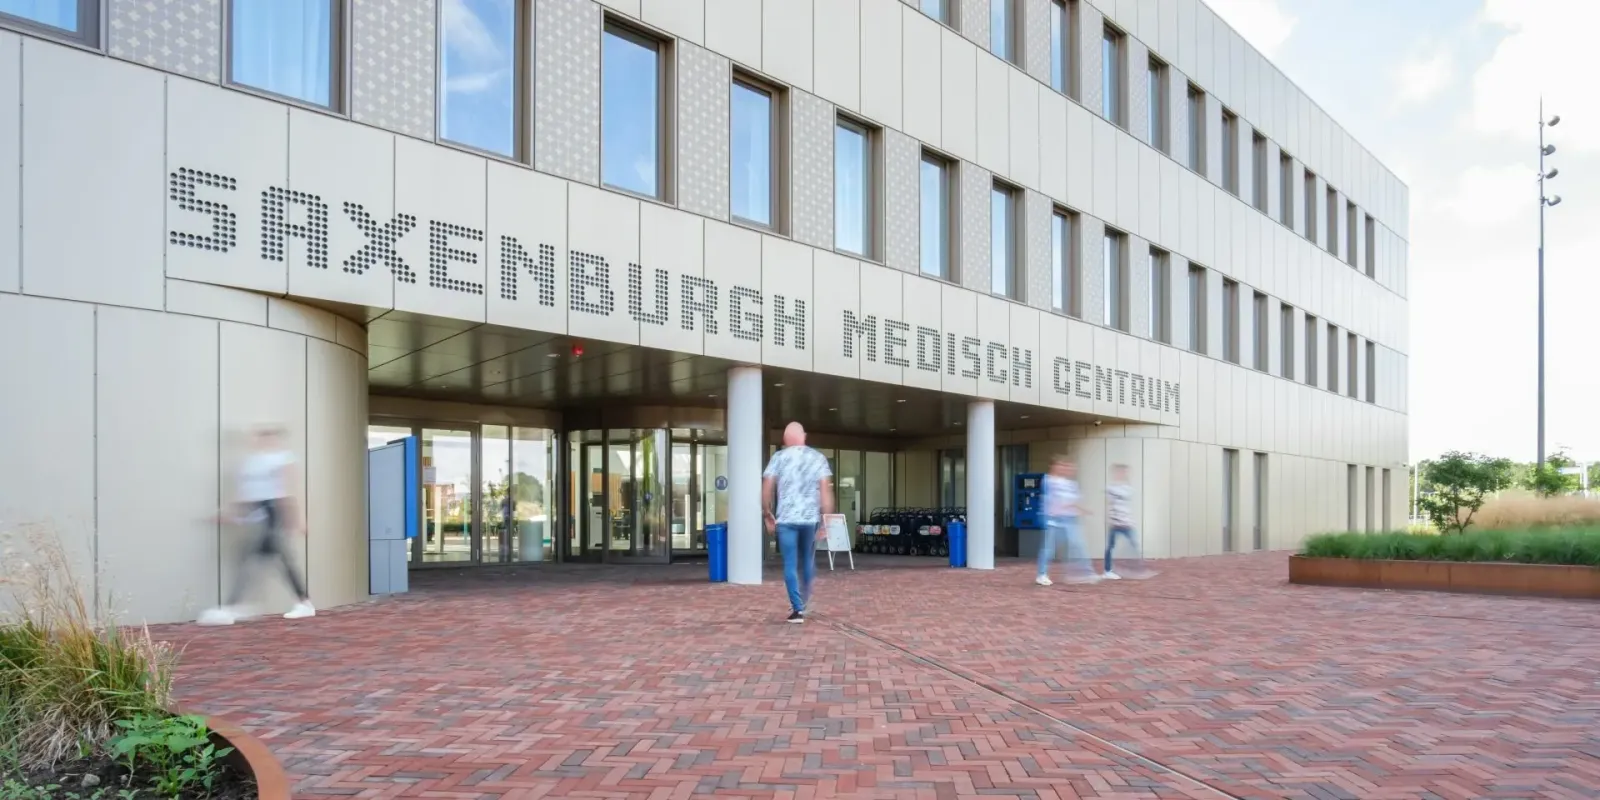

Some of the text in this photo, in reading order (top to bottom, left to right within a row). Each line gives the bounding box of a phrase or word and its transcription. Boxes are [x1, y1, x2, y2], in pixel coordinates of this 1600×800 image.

[169, 166, 1181, 414] SAXENBURGH MEDISCH CENTRUM
